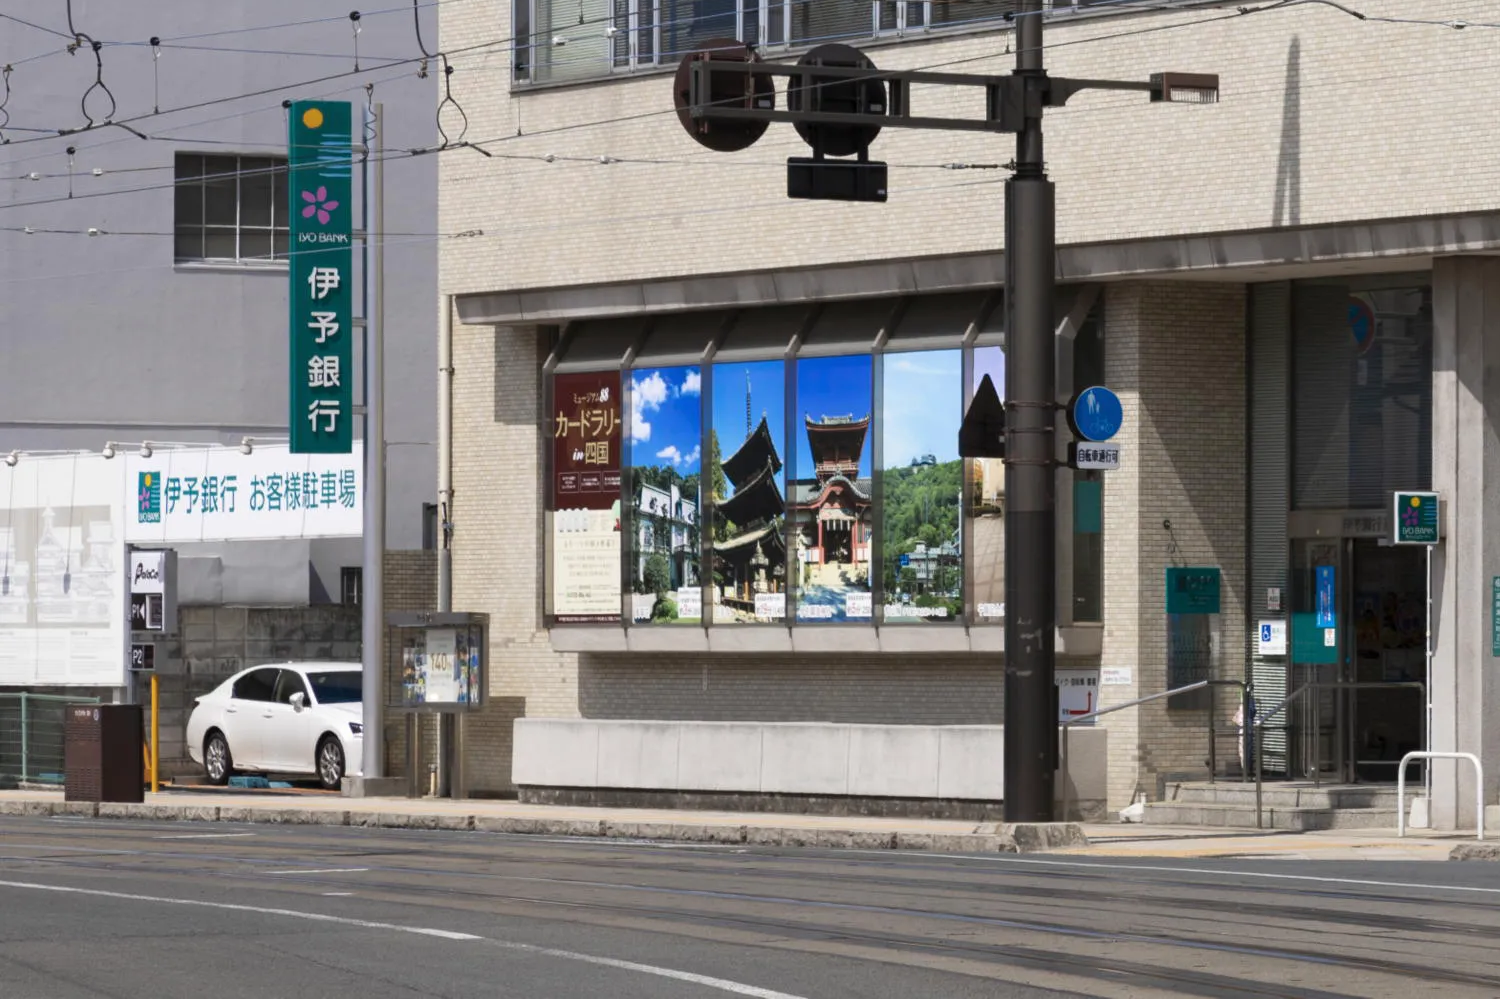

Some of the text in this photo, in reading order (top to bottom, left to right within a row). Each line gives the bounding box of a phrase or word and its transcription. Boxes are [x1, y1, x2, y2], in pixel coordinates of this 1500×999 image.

[298, 232, 348, 243] IYO BANK
[308, 266, 340, 432] 伊予銀行
[555, 408, 621, 438] カードラリー
[585, 441, 609, 464] 四国
[1078, 448, 1119, 463] 自転車通行可
[164, 470, 356, 514] 伊予銀行 お客様駐車場
